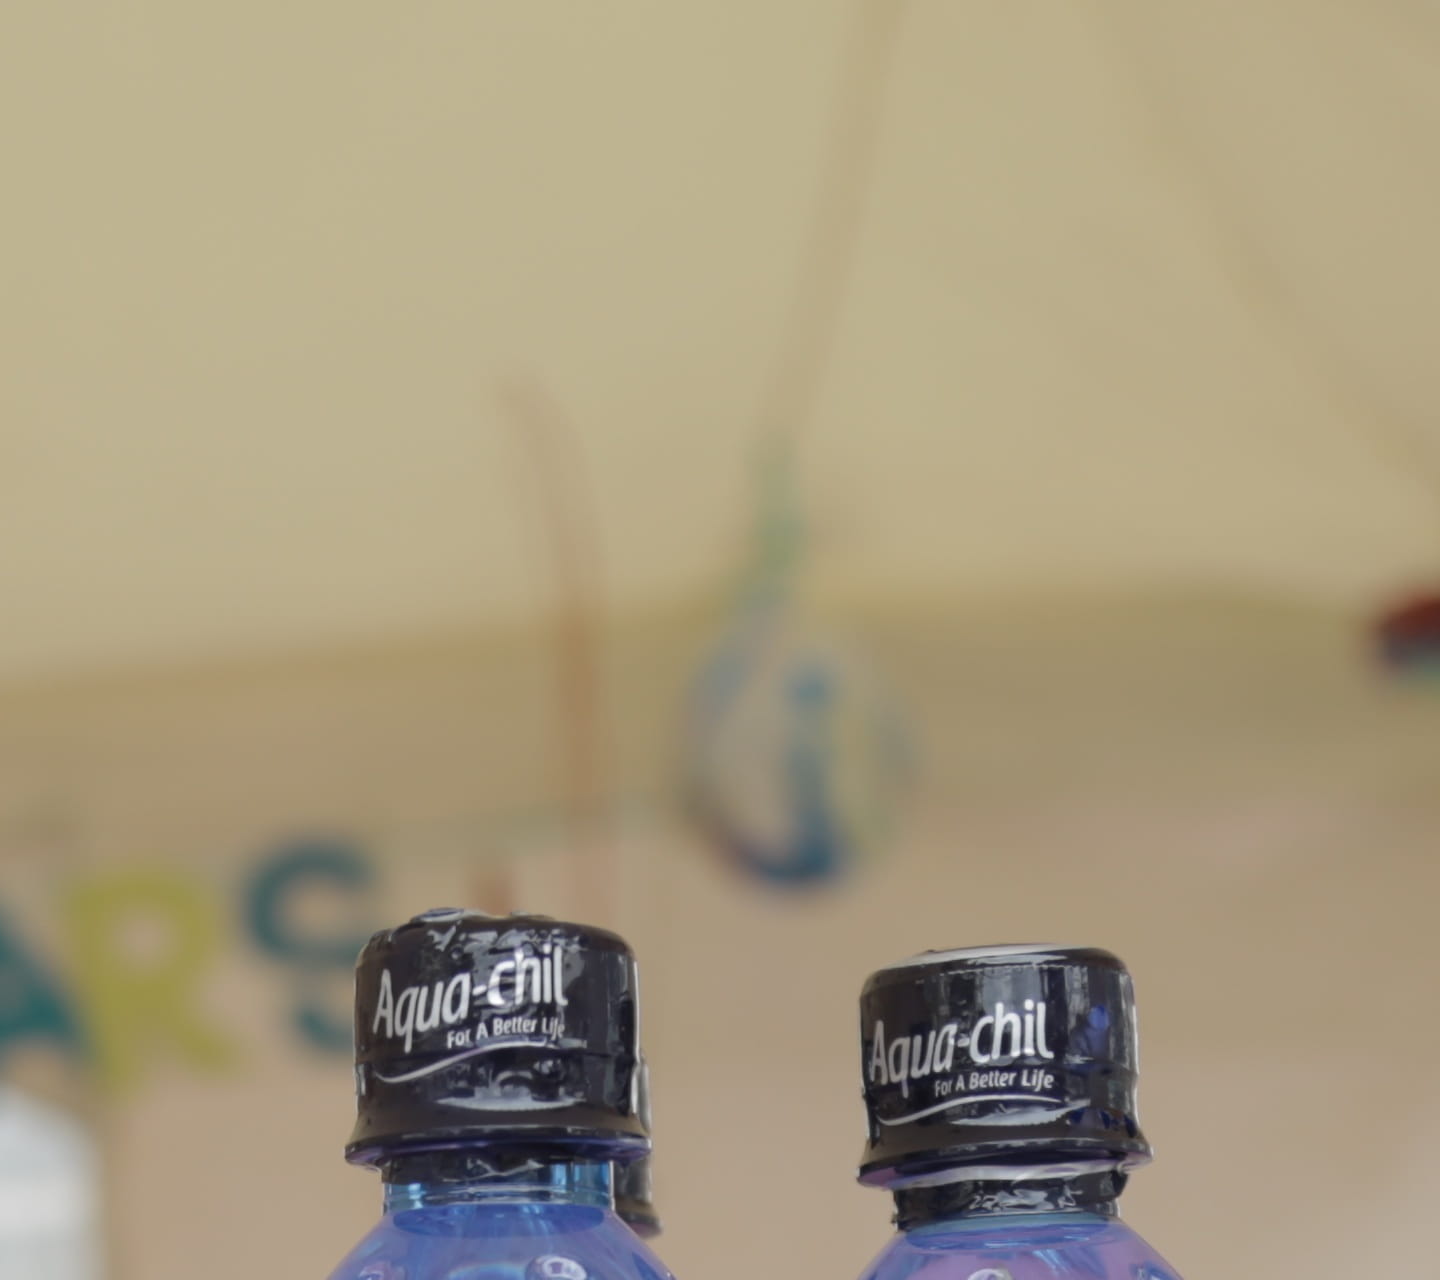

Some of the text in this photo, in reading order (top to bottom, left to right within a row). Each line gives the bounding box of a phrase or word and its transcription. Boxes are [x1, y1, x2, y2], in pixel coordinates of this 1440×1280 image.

[373, 943, 568, 1053] Aqua-chil
[447, 1018, 565, 1048] For A Better Life
[870, 999, 1054, 1098] Aqua-chil
[935, 1069, 1054, 1097] For A Better Life
